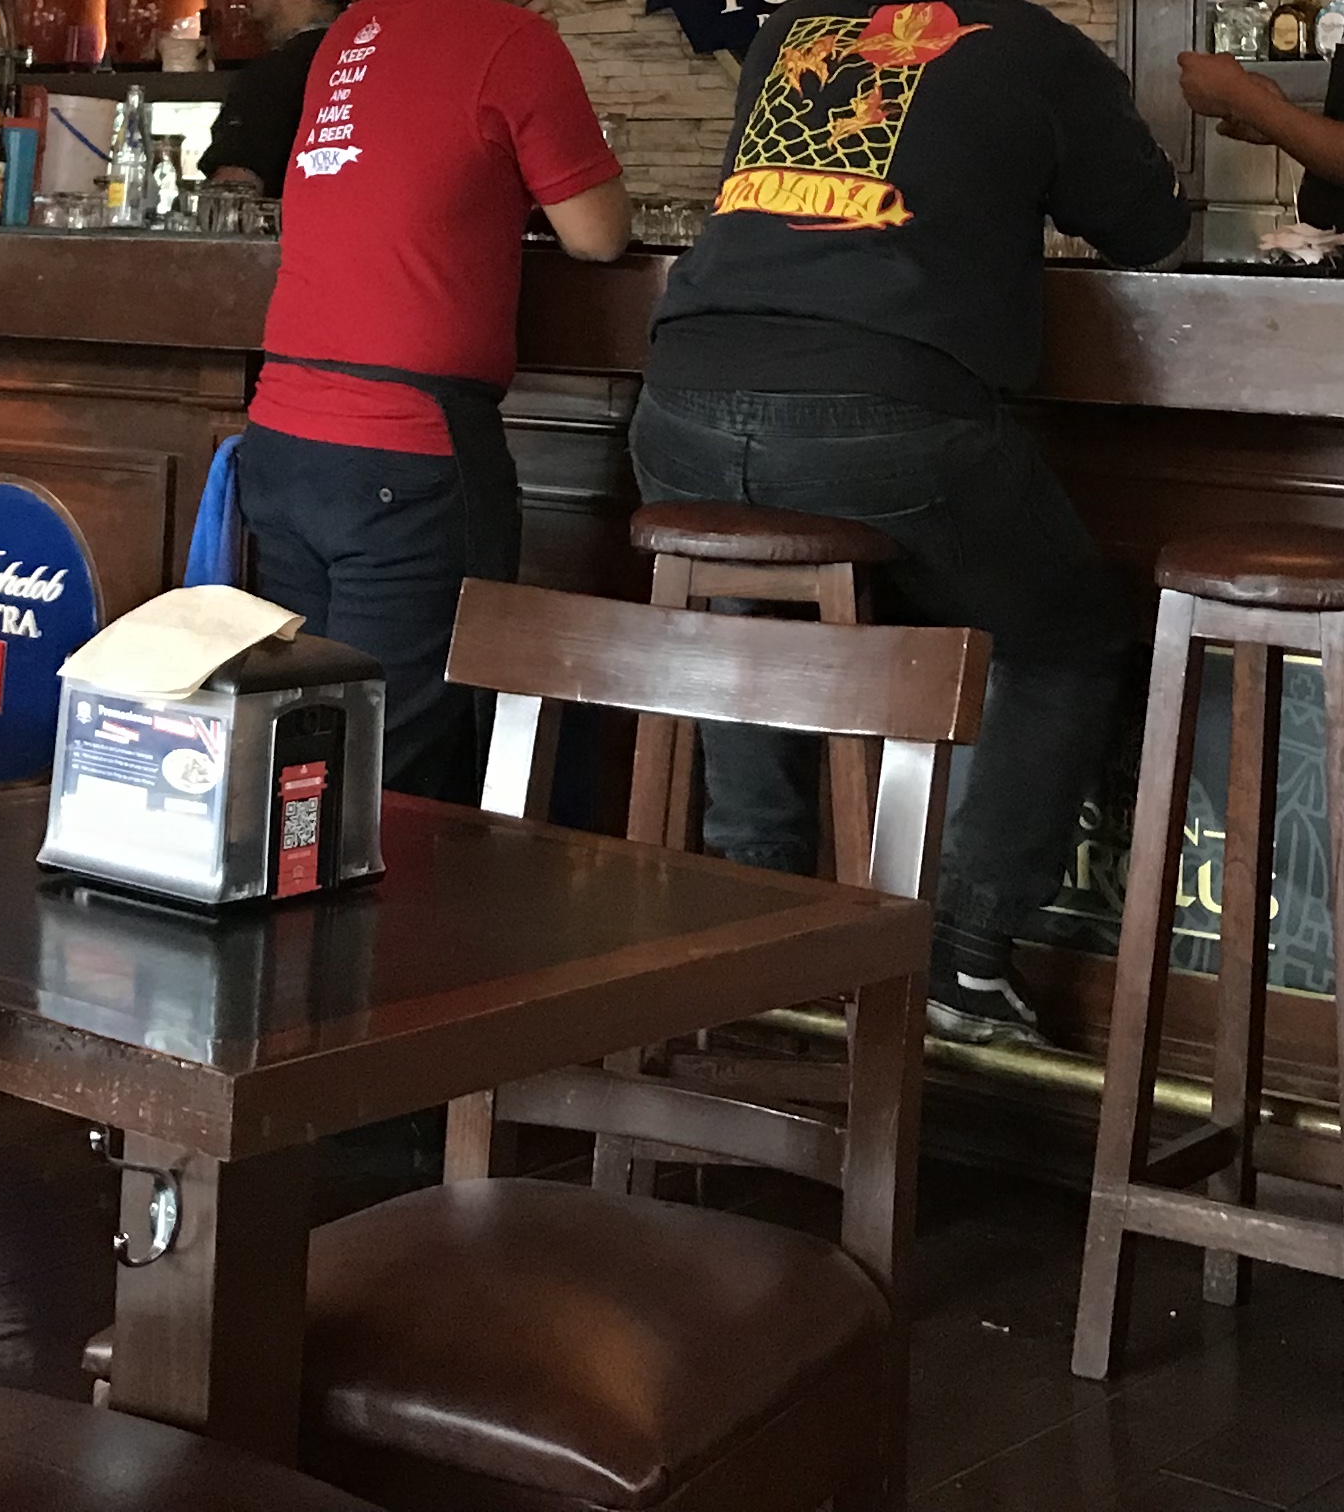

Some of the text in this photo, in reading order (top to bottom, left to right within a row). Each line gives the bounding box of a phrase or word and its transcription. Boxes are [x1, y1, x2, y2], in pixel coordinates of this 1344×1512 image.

[337, 46, 376, 65] KEEP
[329, 65, 367, 87] CALM
[330, 89, 351, 102] AND
[316, 104, 353, 124] HAVE
[305, 124, 354, 146] A BEER
[310, 150, 340, 168] YORK
